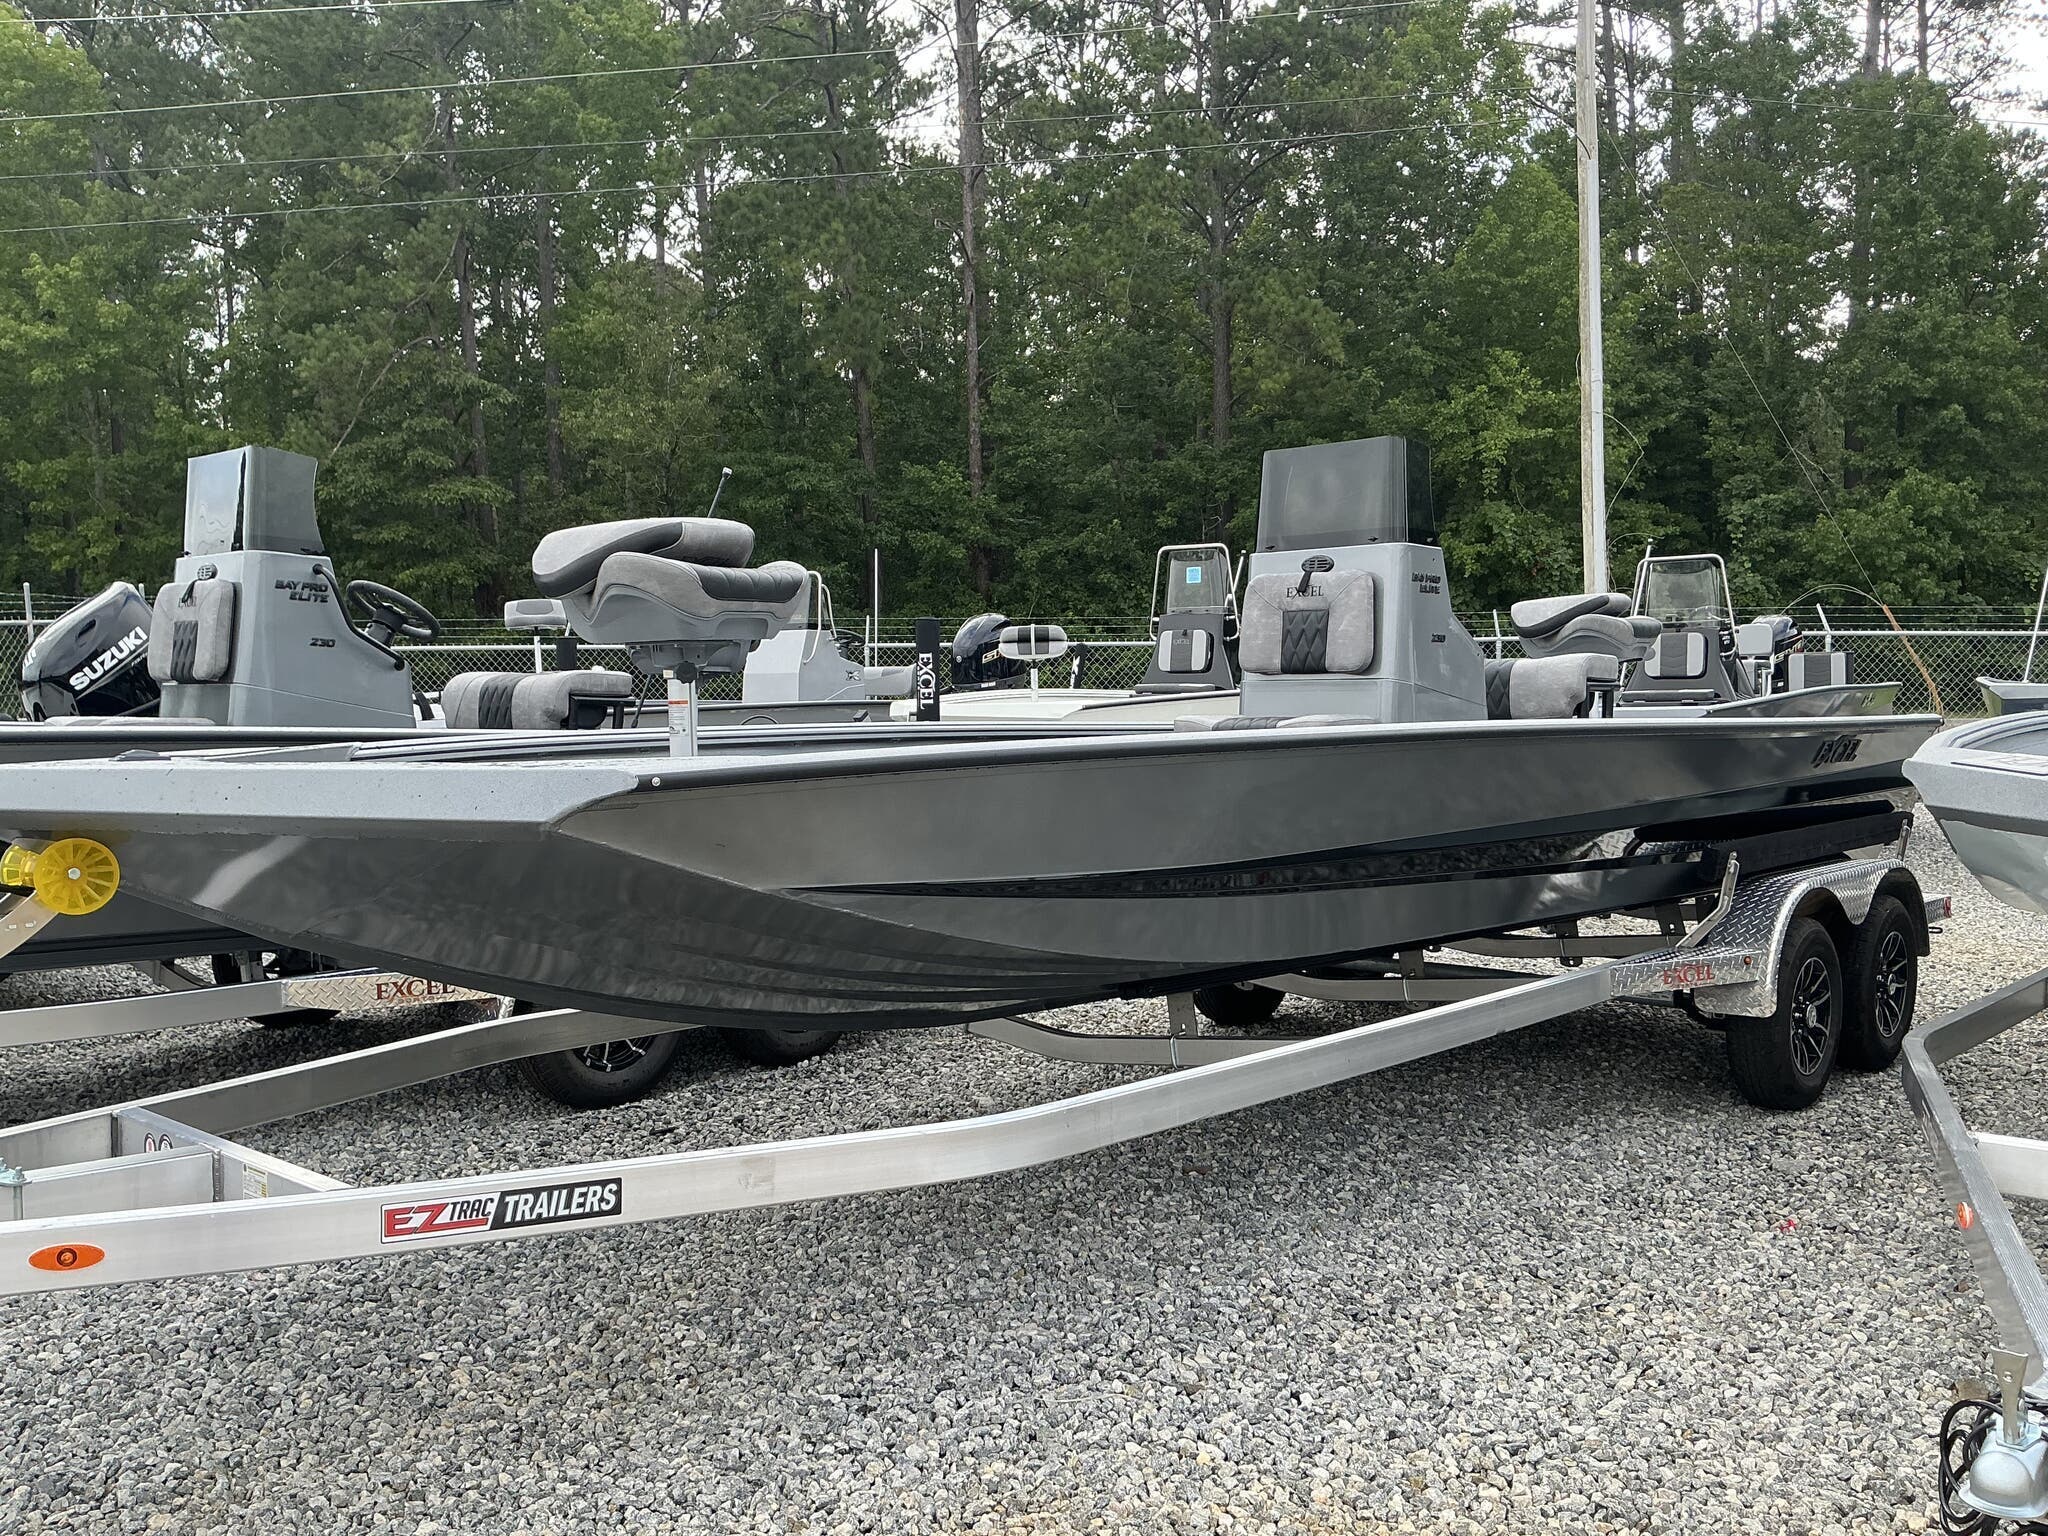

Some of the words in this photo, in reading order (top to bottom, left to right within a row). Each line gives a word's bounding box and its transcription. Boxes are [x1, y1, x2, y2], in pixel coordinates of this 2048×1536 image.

[275, 580, 301, 590] BAY
[301, 582, 329, 592] PRO
[289, 591, 329, 603] ELITE
[310, 637, 336, 648] 230
[69, 626, 148, 691] SUZUKI
[918, 652, 936, 710] EXCEL
[1663, 963, 1715, 985] EXCEL
[375, 977, 456, 1001] EXCEL
[449, 1198, 495, 1222] TRAC
[504, 1183, 617, 1224] TRAILERS
